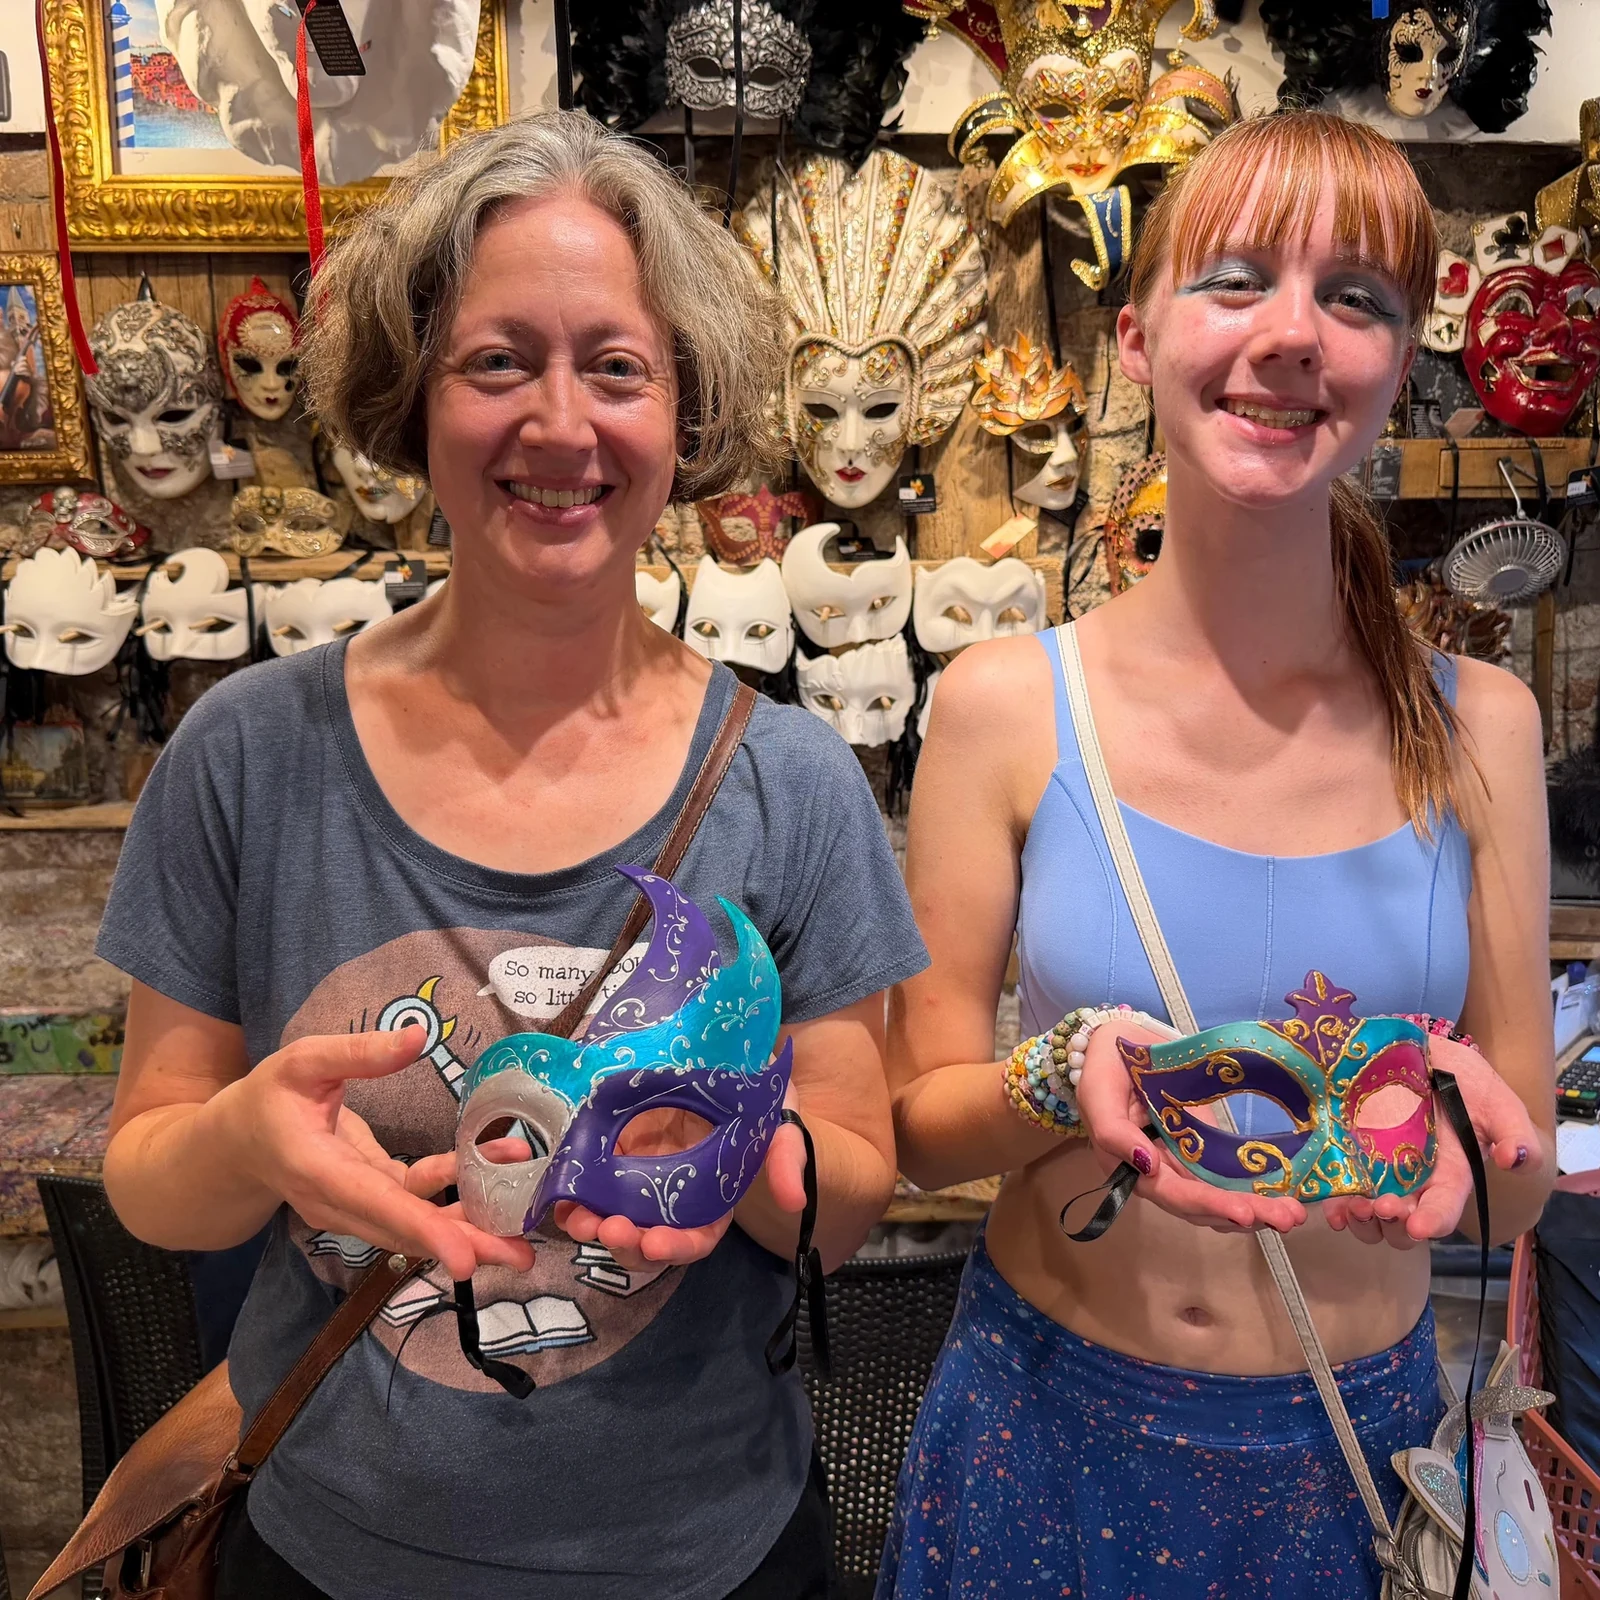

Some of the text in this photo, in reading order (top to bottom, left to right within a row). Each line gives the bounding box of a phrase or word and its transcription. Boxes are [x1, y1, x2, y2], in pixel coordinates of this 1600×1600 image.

[504, 959, 529, 977] So
[538, 966, 595, 986] many
[513, 990, 537, 1005] so
[545, 987, 595, 1006] litt
